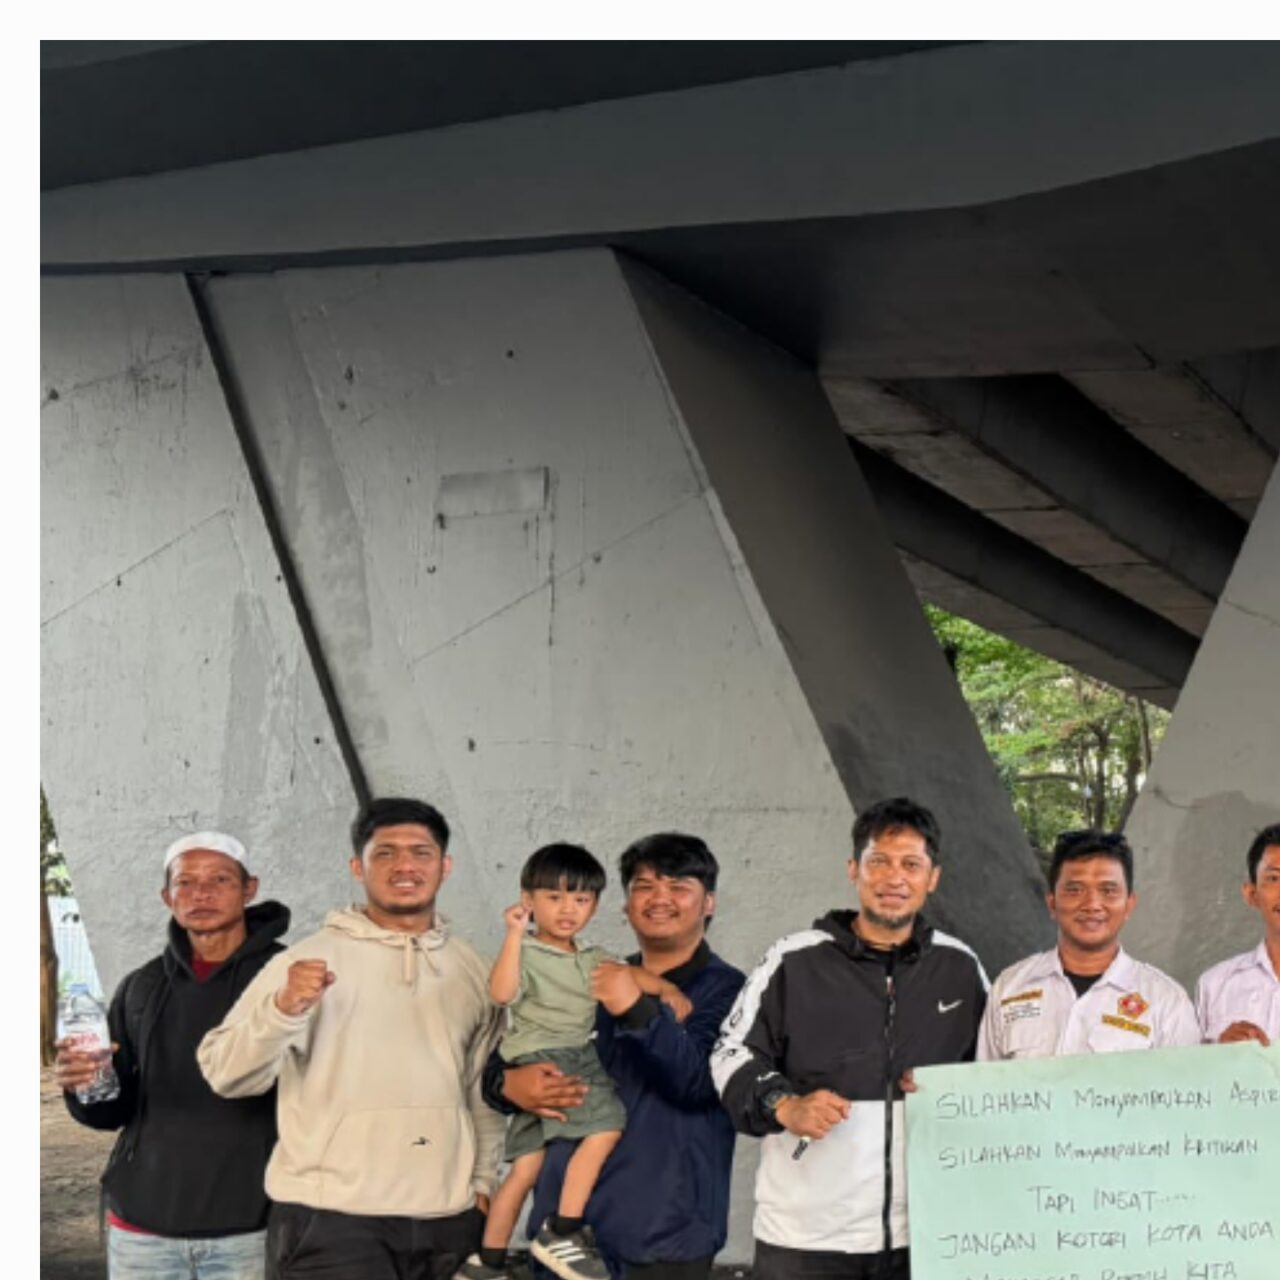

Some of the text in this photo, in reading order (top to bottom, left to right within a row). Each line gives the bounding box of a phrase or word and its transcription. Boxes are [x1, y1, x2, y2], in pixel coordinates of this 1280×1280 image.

[935, 1088, 1052, 1120] SILAHKAN
[938, 1143, 1041, 1169] SILAHKAN
[1026, 1184, 1076, 1214] TAPI
[936, 1231, 1036, 1259] JANGAN
[1147, 1222, 1203, 1247] KOTA
[1216, 1219, 1276, 1242] ANDA
